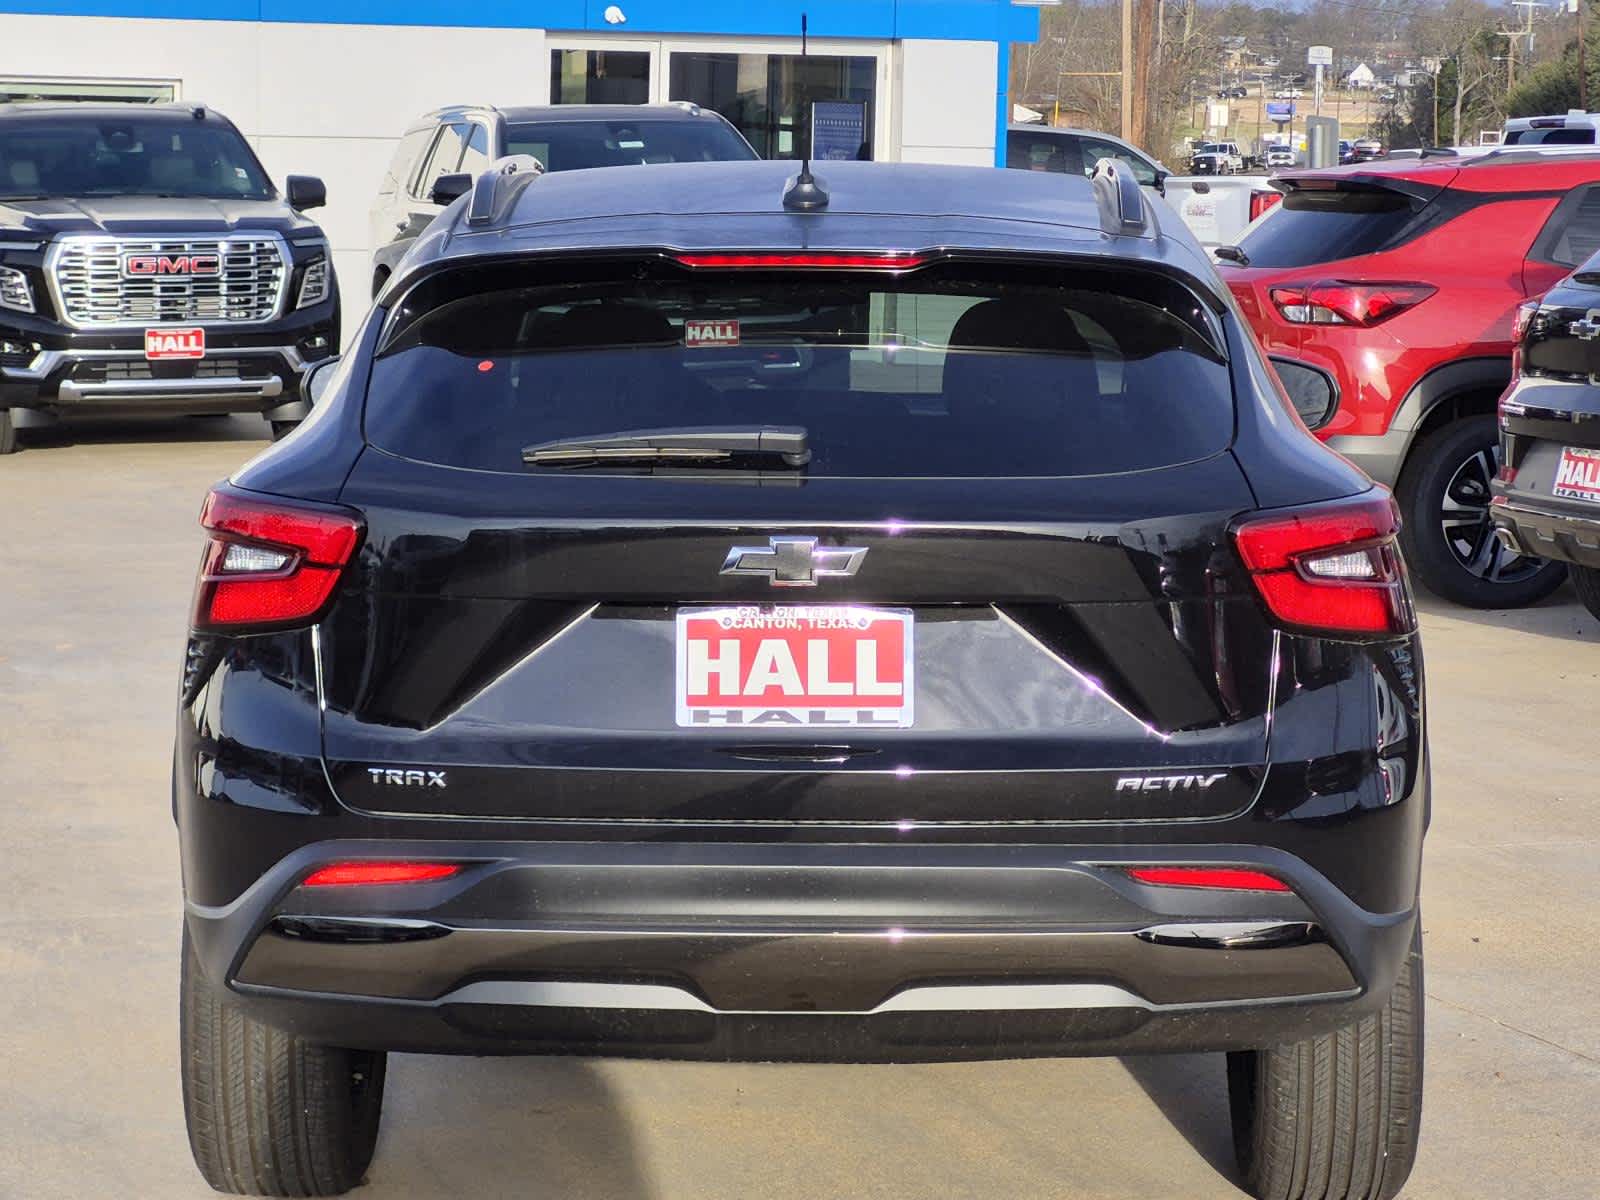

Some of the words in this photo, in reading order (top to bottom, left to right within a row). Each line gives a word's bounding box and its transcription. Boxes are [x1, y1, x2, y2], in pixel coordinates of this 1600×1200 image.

[128, 256, 218, 273] GMC
[688, 326, 737, 340] HALL
[147, 335, 203, 352] HALL
[1558, 459, 1600, 488] HAL
[732, 618, 802, 631] CANTON,
[807, 618, 856, 629] TEXAS
[687, 639, 903, 696] HALL
[692, 710, 898, 724] HALL
[367, 767, 447, 787] TRAX
[1115, 773, 1228, 791] ACTIV
